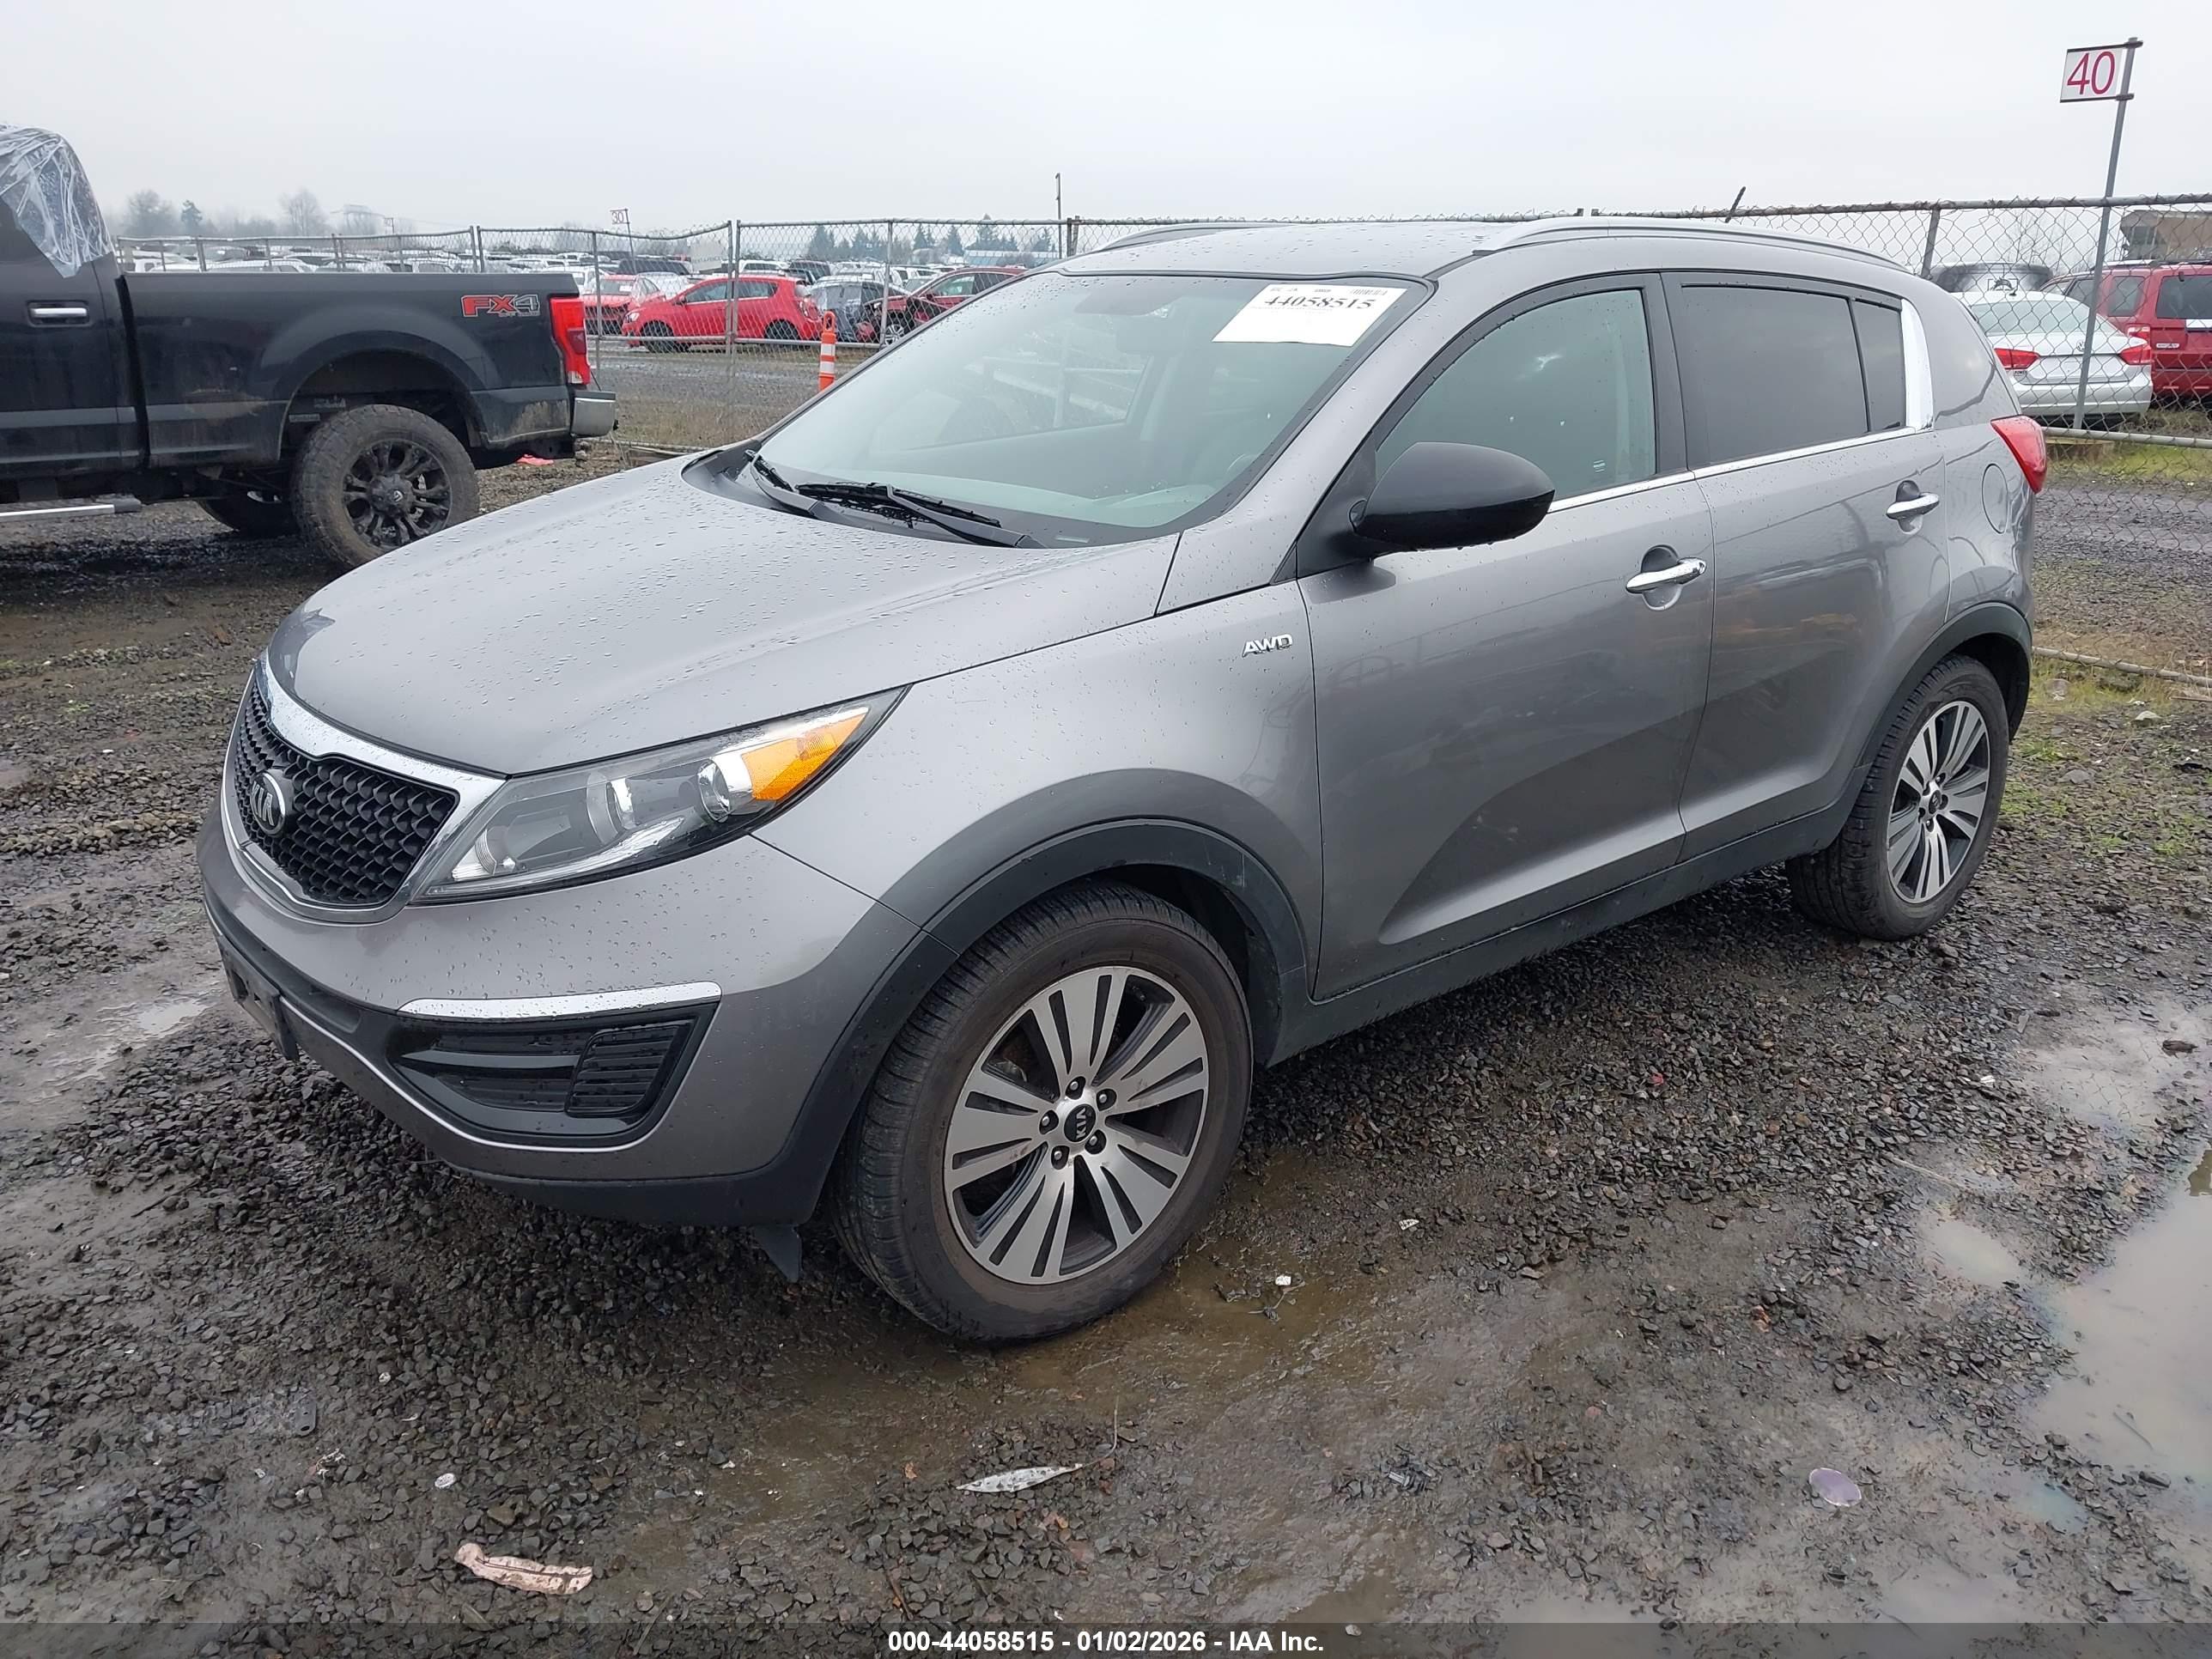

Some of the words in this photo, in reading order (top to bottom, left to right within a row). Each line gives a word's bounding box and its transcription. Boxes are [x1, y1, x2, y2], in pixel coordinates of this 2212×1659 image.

[2067, 51, 2115, 95] 40
[611, 211, 624, 223] 30
[461, 295, 540, 317] FX4
[1265, 295, 1376, 309] 44058515
[1243, 635, 1292, 657] AWD
[250, 781, 275, 826] KIA
[1076, 1108, 1086, 1139] KIA
